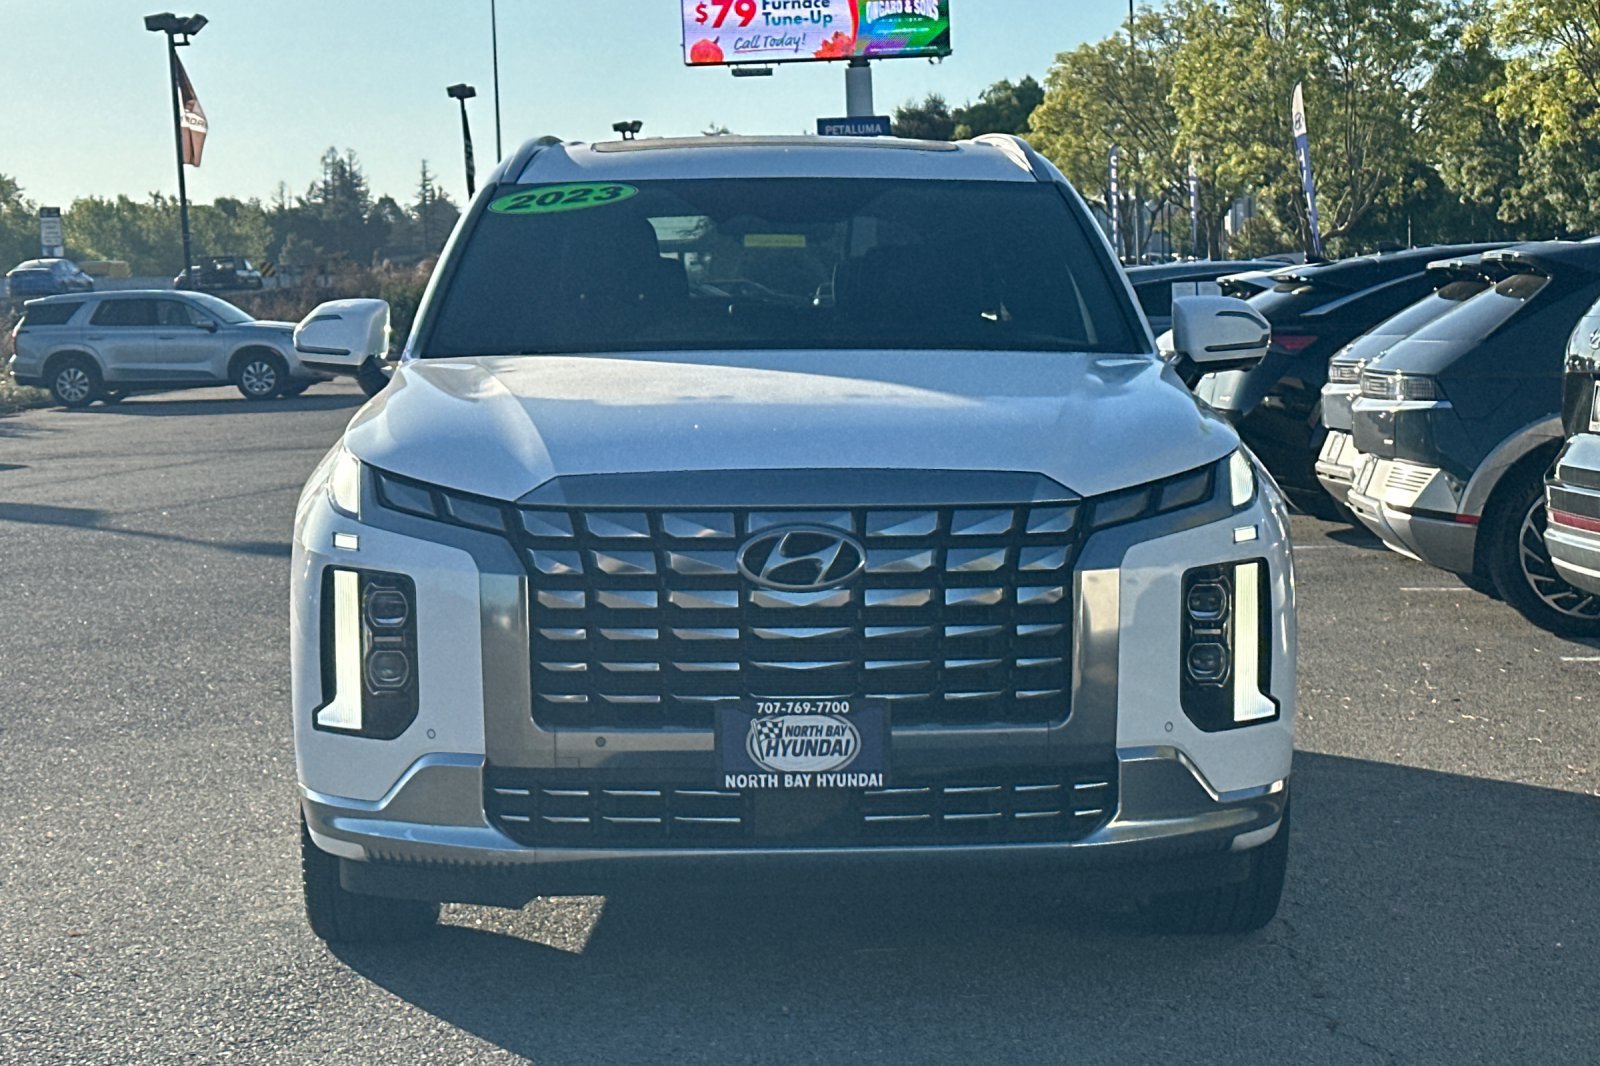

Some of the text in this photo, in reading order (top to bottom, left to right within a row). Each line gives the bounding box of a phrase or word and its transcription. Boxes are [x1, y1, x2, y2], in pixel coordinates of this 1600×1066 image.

[762, 0, 831, 10] Furnace
[695, 0, 757, 28] $79
[762, 10, 833, 28] Tune-Up
[734, 33, 806, 53] Call Today!
[824, 123, 882, 136] PETALUMA
[503, 185, 624, 211] 2023
[756, 701, 850, 714] 707-769-7700
[784, 724, 849, 738] NORTH BAY
[765, 738, 851, 758] HYUNDAI
[725, 773, 884, 789] NORTH BAY HYUNDAI
